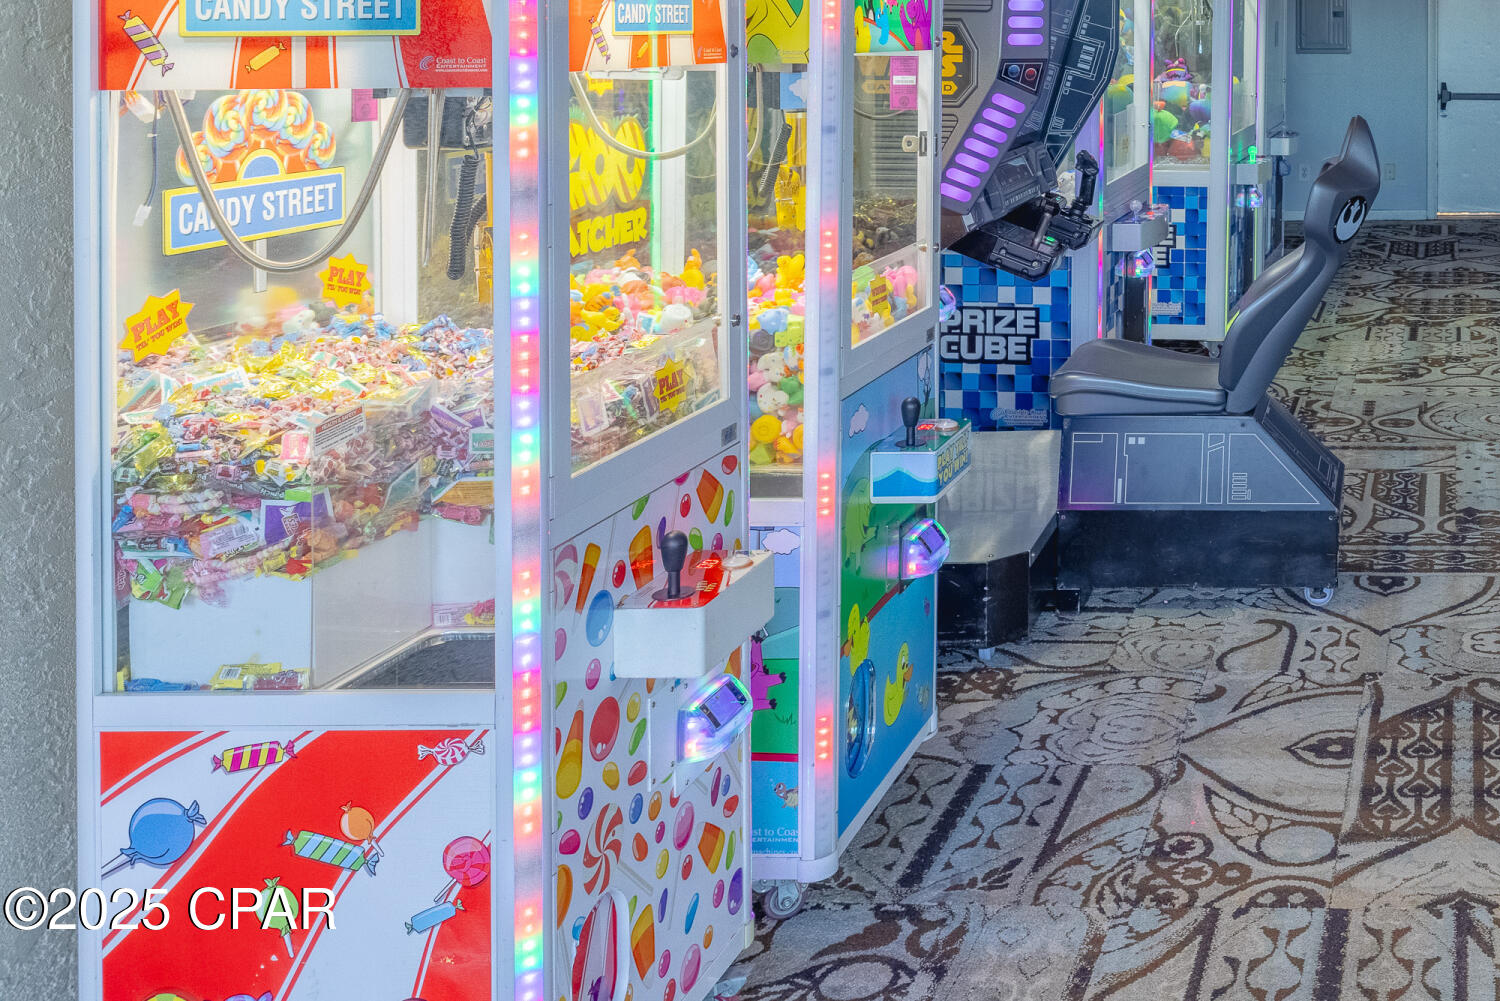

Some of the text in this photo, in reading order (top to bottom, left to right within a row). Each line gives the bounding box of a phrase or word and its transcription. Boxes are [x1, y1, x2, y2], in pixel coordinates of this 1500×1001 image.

[617, 3, 690, 24] CANDY STREET
[436, 56, 456, 65] Coast
[467, 56, 487, 65] Coast
[261, 182, 337, 222] STREET
[328, 266, 366, 288] PLAY
[131, 299, 180, 344] PLAY
[941, 308, 1037, 336] PRIZE
[150, 328, 165, 343] YOU
[940, 334, 1029, 361] CUBE
[658, 368, 684, 396] PLAY
[937, 445, 955, 471] PLAY
[937, 461, 954, 487] YOU
